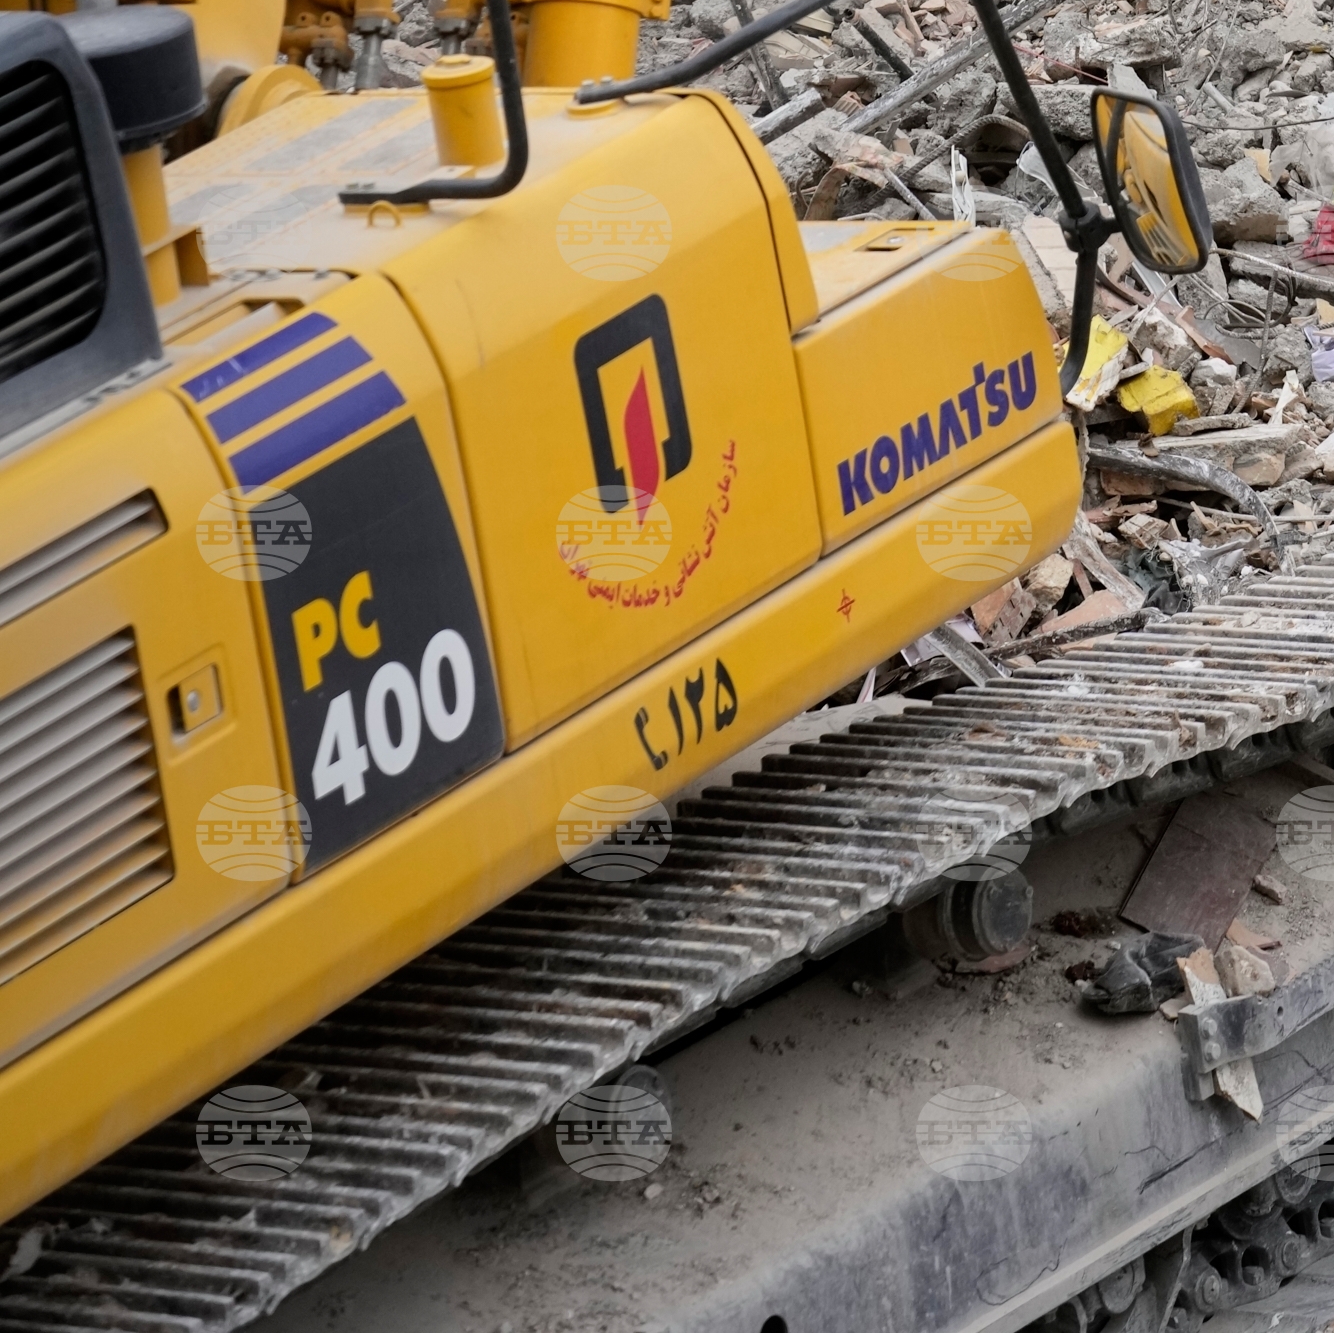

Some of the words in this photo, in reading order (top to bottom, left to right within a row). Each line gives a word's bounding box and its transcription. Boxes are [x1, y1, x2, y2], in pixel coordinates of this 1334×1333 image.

[717, 439, 737, 514] سازمان
[836, 350, 1037, 516] KOMATSU
[291, 570, 382, 693] PC
[311, 628, 476, 806] 400
[668, 657, 738, 756] ۱۲۵
